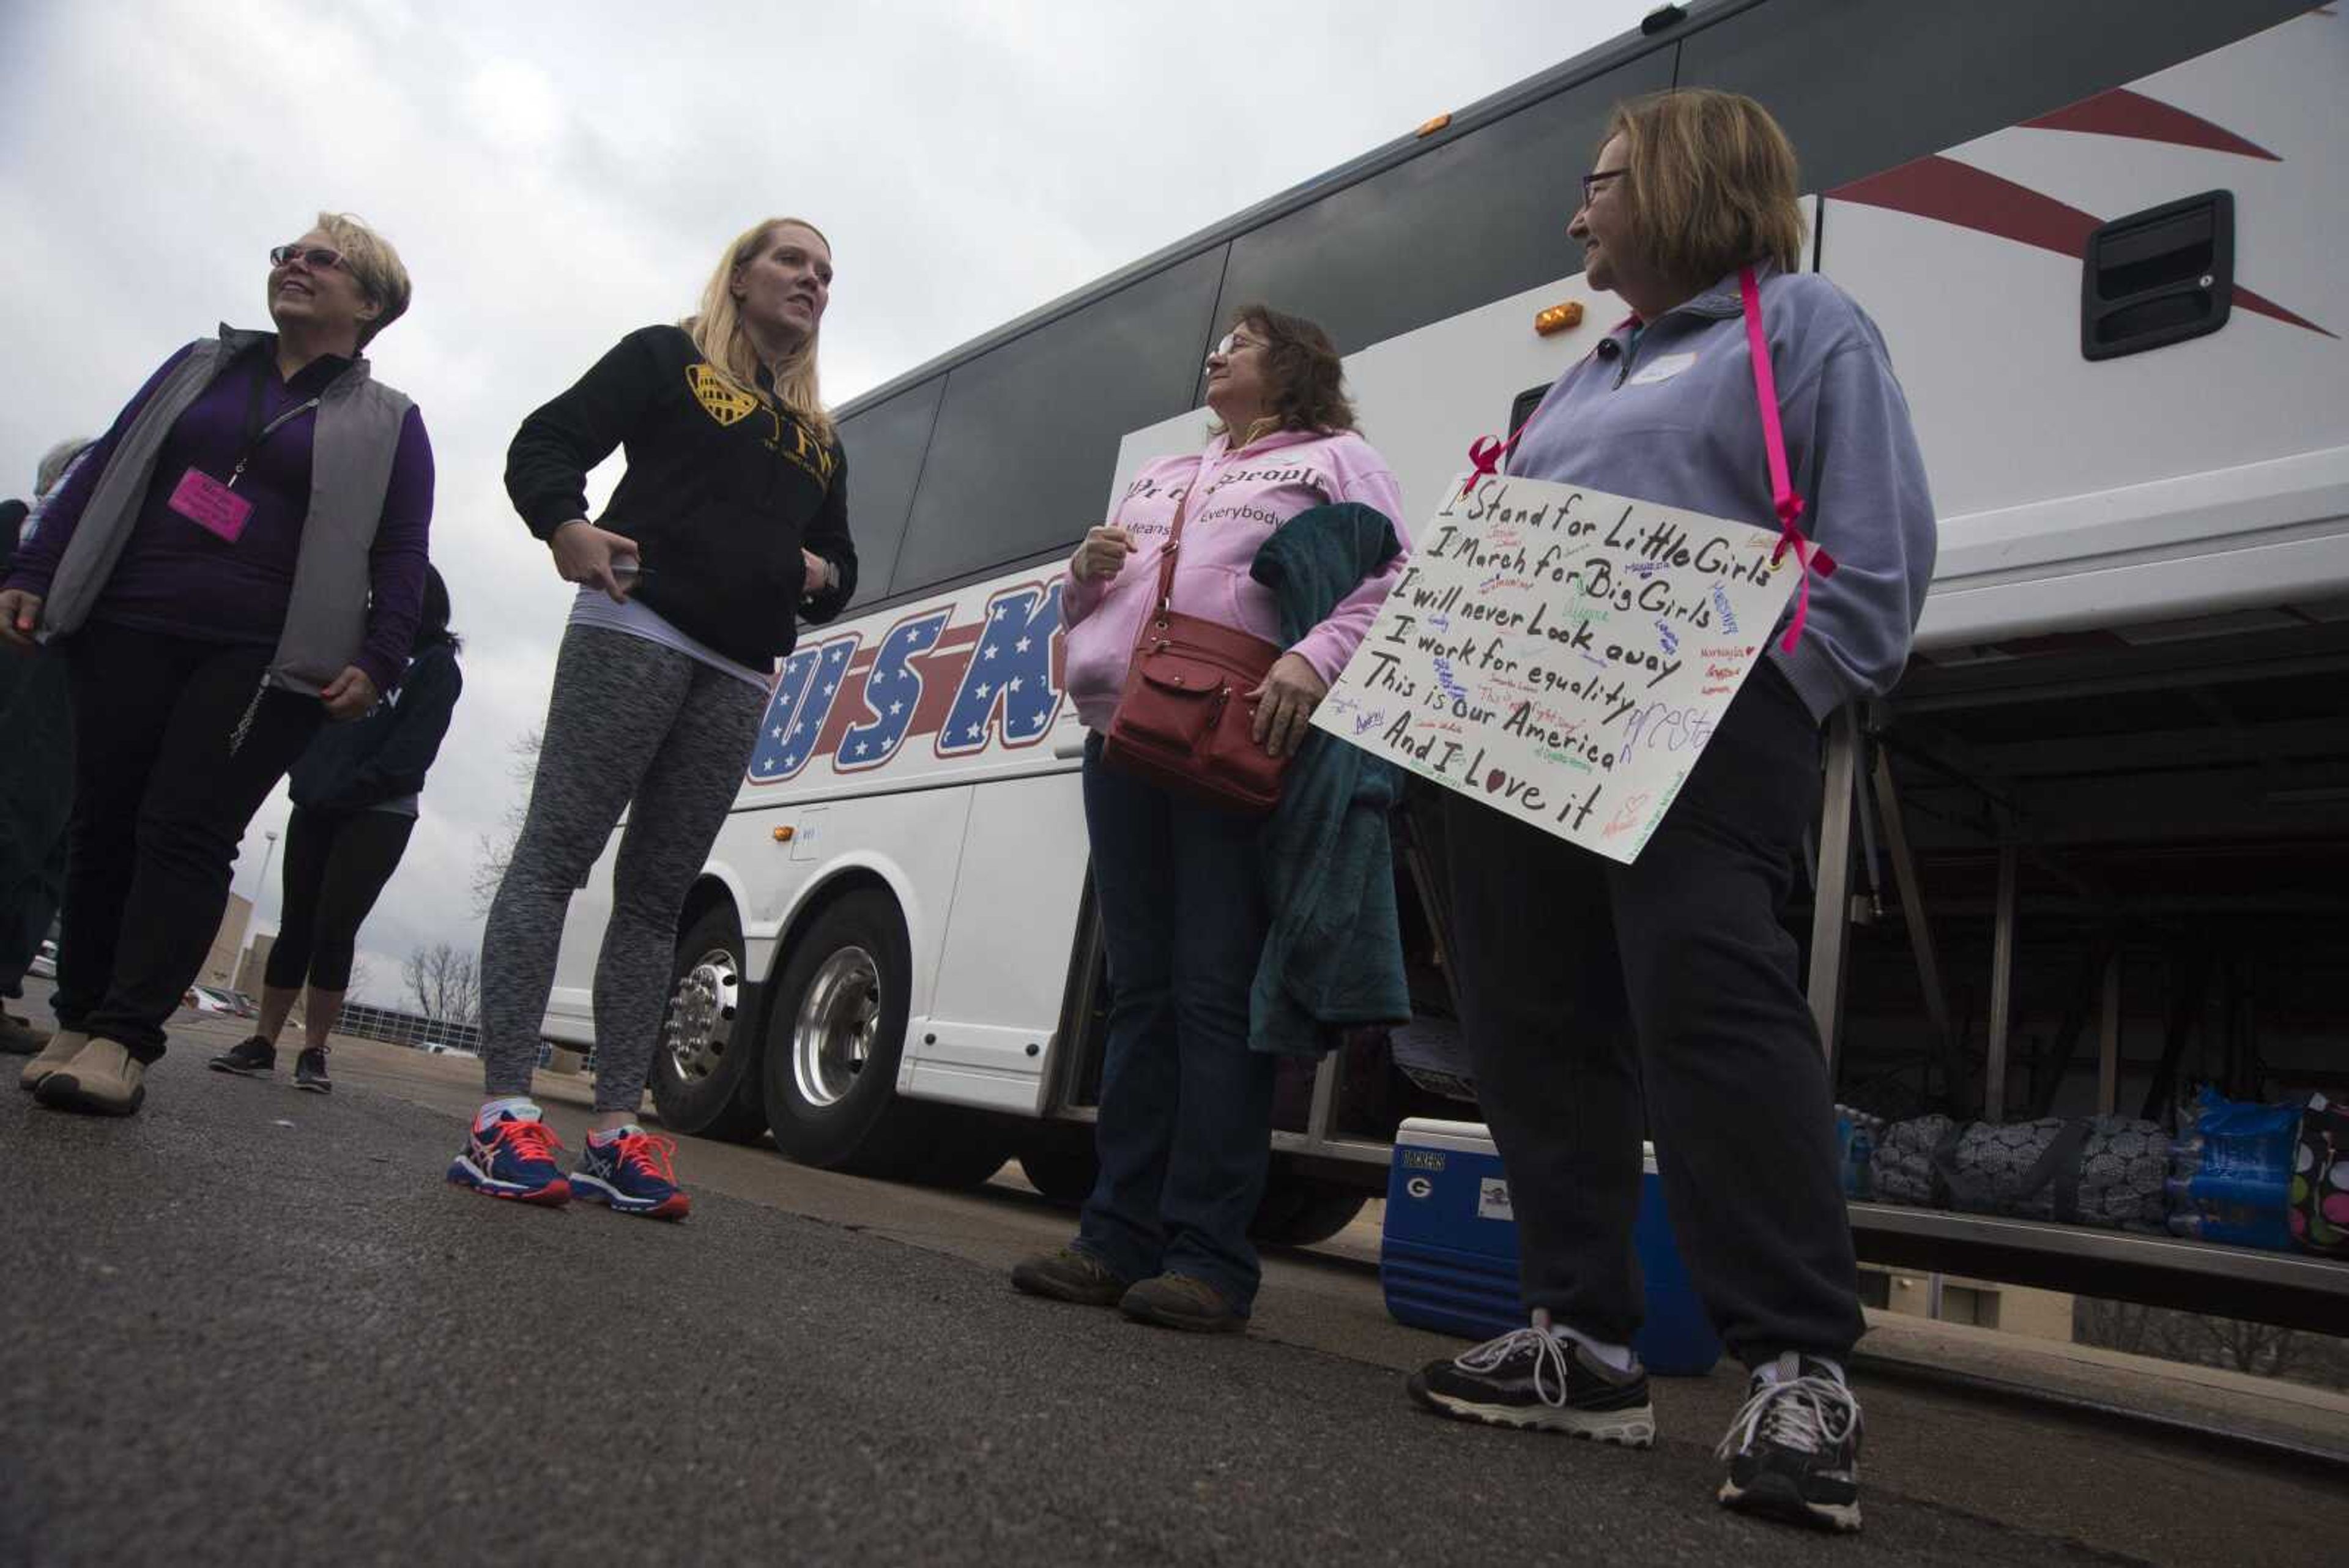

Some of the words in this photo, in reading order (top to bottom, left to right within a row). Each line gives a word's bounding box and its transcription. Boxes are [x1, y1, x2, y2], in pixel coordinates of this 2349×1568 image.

[1200, 503, 1284, 531] Everybody
[1439, 477, 1468, 516] I
[1468, 480, 1549, 527] Stand
[1552, 492, 1597, 537] for
[1604, 505, 1691, 567] Little
[1694, 537, 1772, 587] Girls
[1392, 567, 1420, 598] I
[1413, 585, 1463, 612] will
[1460, 601, 1524, 627] never
[1526, 602, 1594, 651] Look
[1606, 644, 1682, 689] away
[1427, 526, 1458, 557] I
[1452, 537, 1527, 574] March
[1534, 544, 1580, 583] for
[1586, 557, 1632, 611] Big
[1638, 580, 1710, 628] Girls
[1364, 650, 1416, 697] This
[1423, 685, 1445, 710] is
[1502, 702, 1615, 773] America
[1385, 614, 1416, 644] I
[1417, 636, 1477, 666] work
[1479, 637, 1518, 673] for
[1527, 666, 1636, 726] equality
[1382, 709, 1436, 760] And
[1432, 740, 1463, 773] I
[1556, 783, 1602, 831] it
